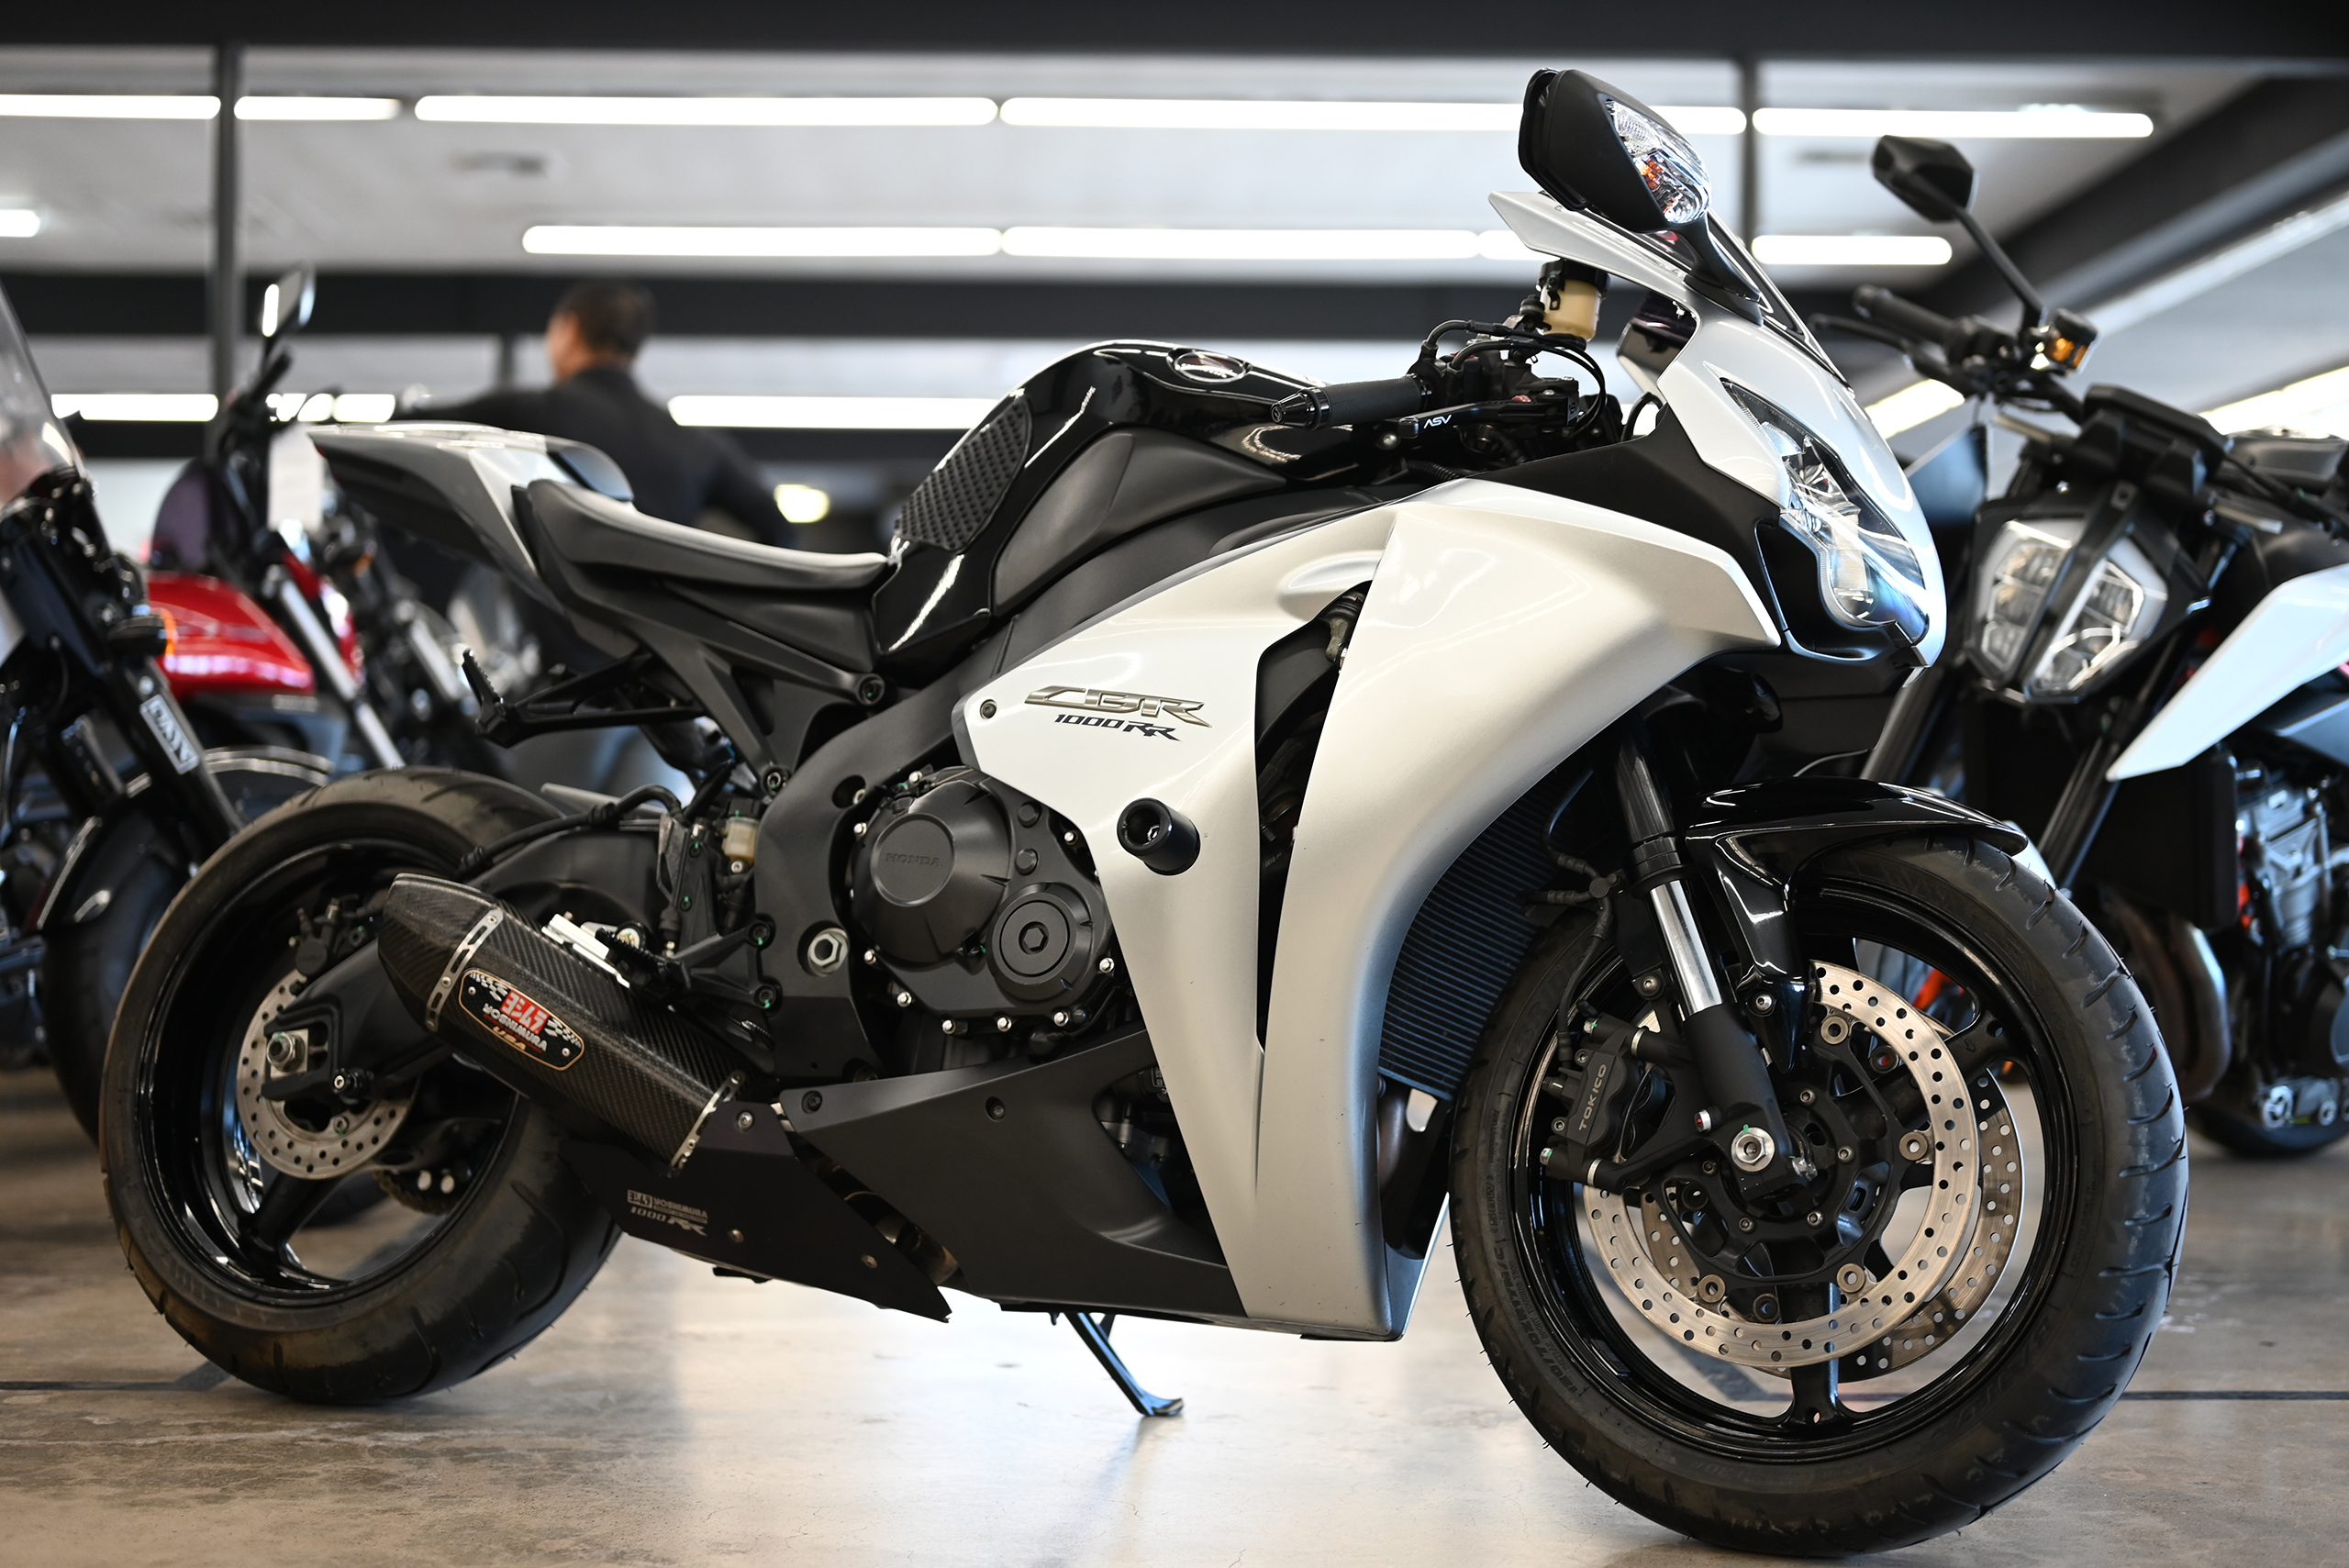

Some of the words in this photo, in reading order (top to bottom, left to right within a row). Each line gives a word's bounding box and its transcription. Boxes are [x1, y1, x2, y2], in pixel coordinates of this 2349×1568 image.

[1423, 414, 1453, 429] ASV
[1024, 685, 1213, 728] CBR
[885, 852, 941, 867] HONDA
[483, 1003, 548, 1051] YOSHIMURA
[1578, 1064, 1608, 1130] TOKICO
